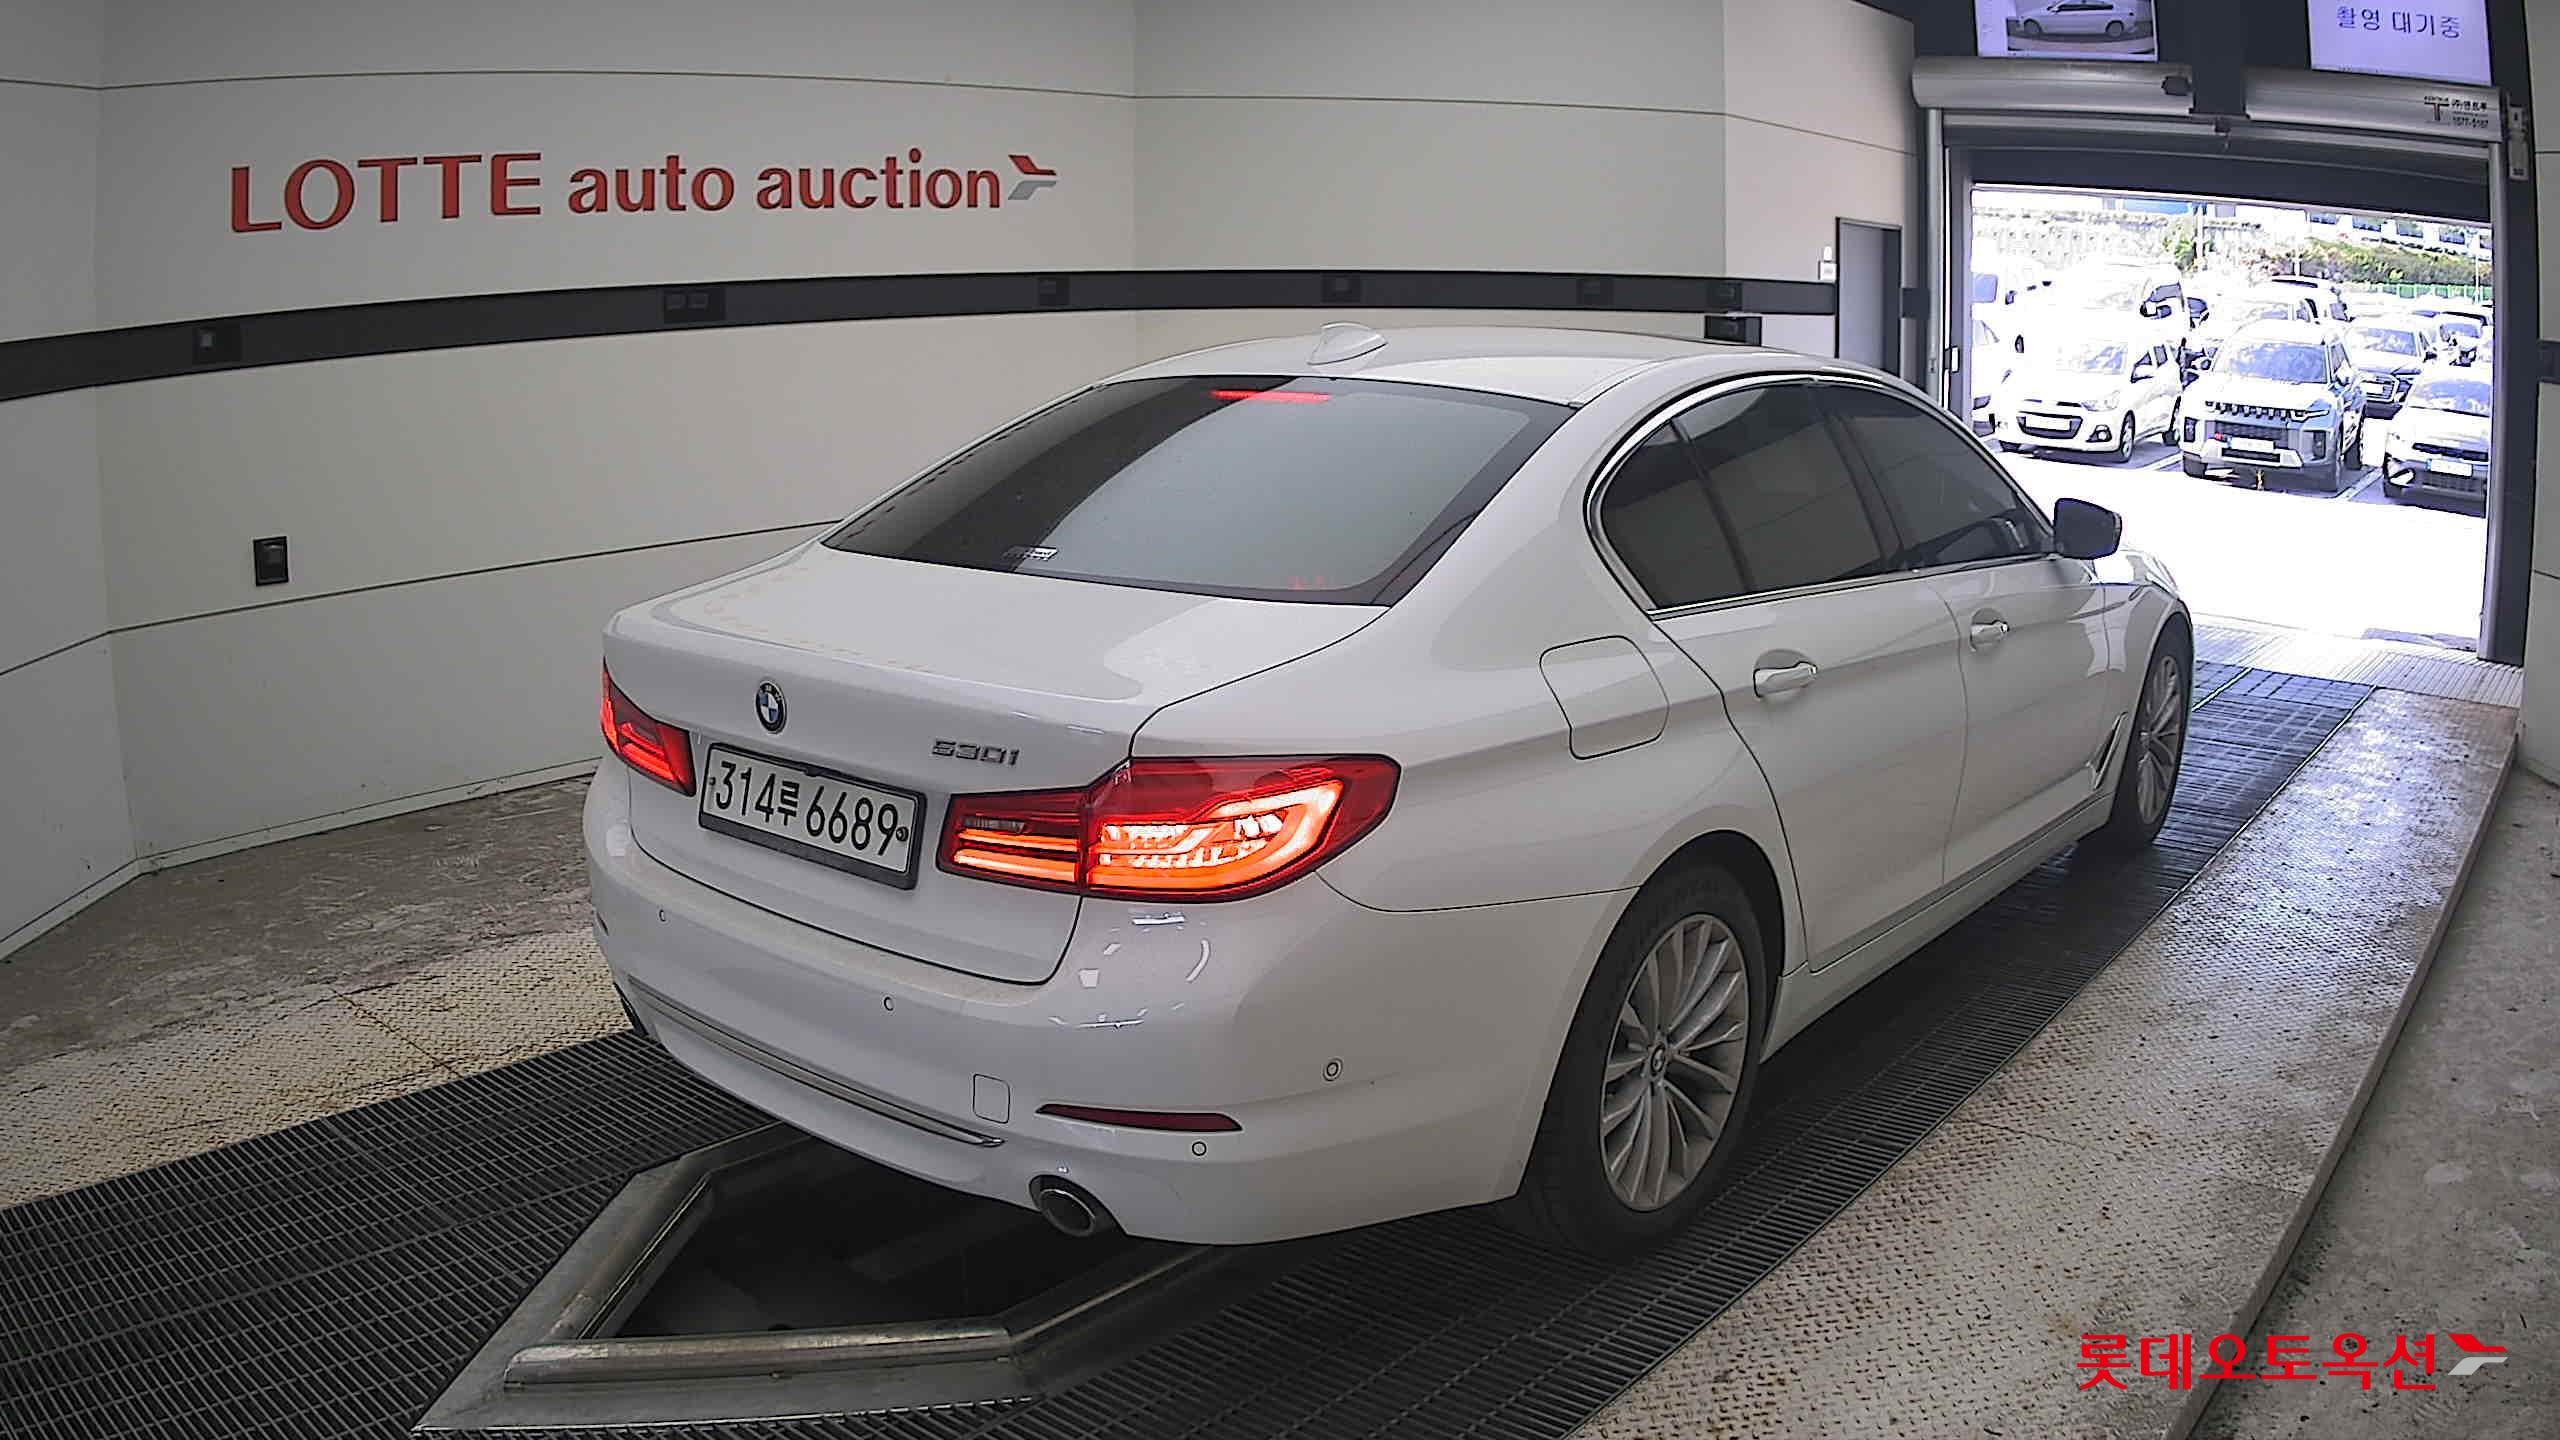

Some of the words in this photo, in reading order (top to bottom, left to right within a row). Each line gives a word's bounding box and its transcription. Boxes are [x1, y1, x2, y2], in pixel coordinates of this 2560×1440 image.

[2337, 6, 2381, 31] 촬영
[231, 152, 542, 233] LOTTE
[568, 154, 735, 213] auto
[757, 148, 1001, 209] auction
[932, 740, 1020, 767] 530i
